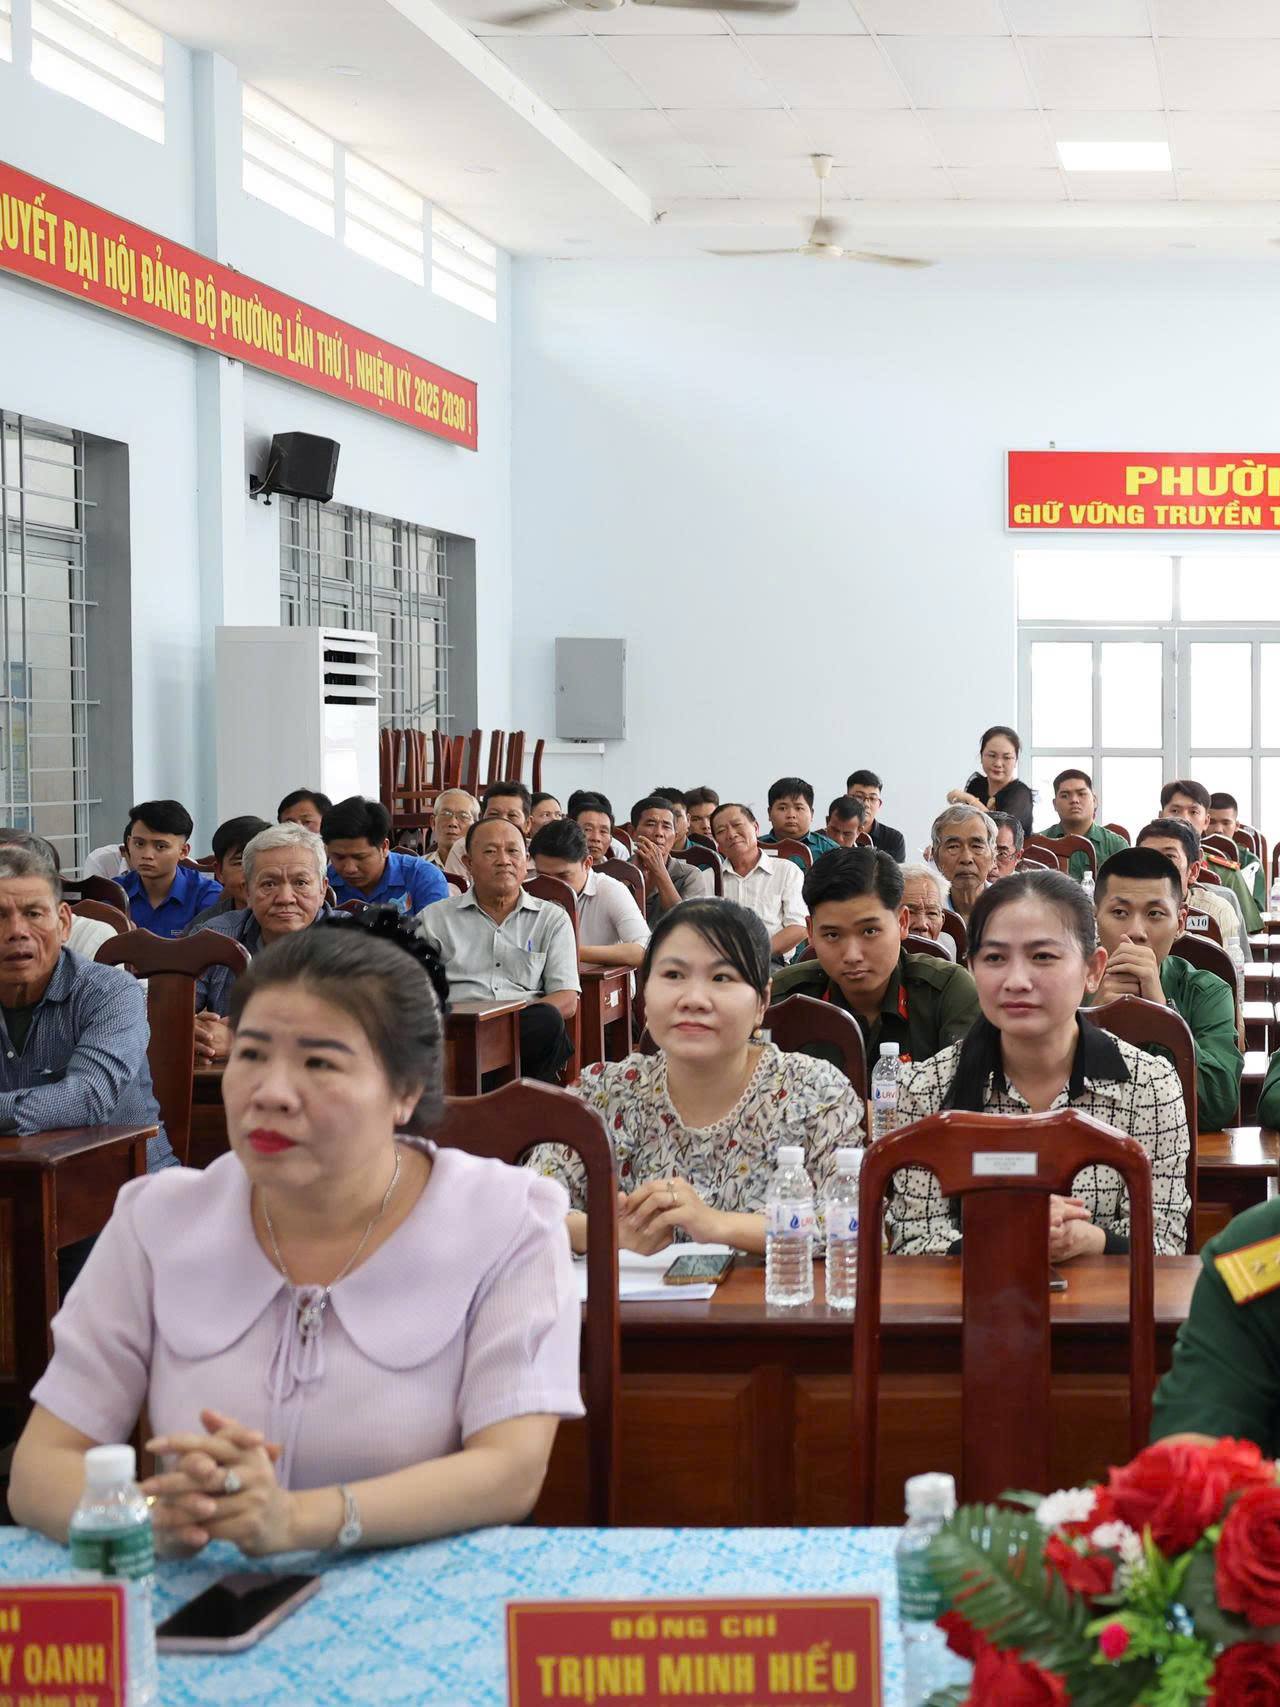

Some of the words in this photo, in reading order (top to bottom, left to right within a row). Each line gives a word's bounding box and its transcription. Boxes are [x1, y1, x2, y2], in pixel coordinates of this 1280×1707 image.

[0, 192, 57, 265] UYẾT
[64, 219, 99, 290] ĐẠI
[104, 234, 137, 305] HỘI
[141, 245, 191, 319] ĐẢNG
[195, 274, 217, 340] BỘ
[221, 293, 283, 357] PHƯỜNG
[287, 308, 314, 369] LẦN
[317, 331, 342, 380] THỨ
[344, 344, 354, 390] I,
[356, 350, 394, 407] NHIỆM
[397, 363, 412, 409] KỲ
[414, 376, 440, 421] 2025
[442, 389, 466, 432] 2030
[1014, 500, 1064, 525] GIỮ
[1070, 501, 1145, 525] VỮNG
[1153, 499, 1262, 527] TRUYỀN
[1187, 918, 1208, 928] A10
[24, 1644, 105, 1685] OANH
[537, 1655, 646, 1704] TRỊNH
[659, 1654, 756, 1695] MINH
[768, 1641, 857, 1693] HIẾU
